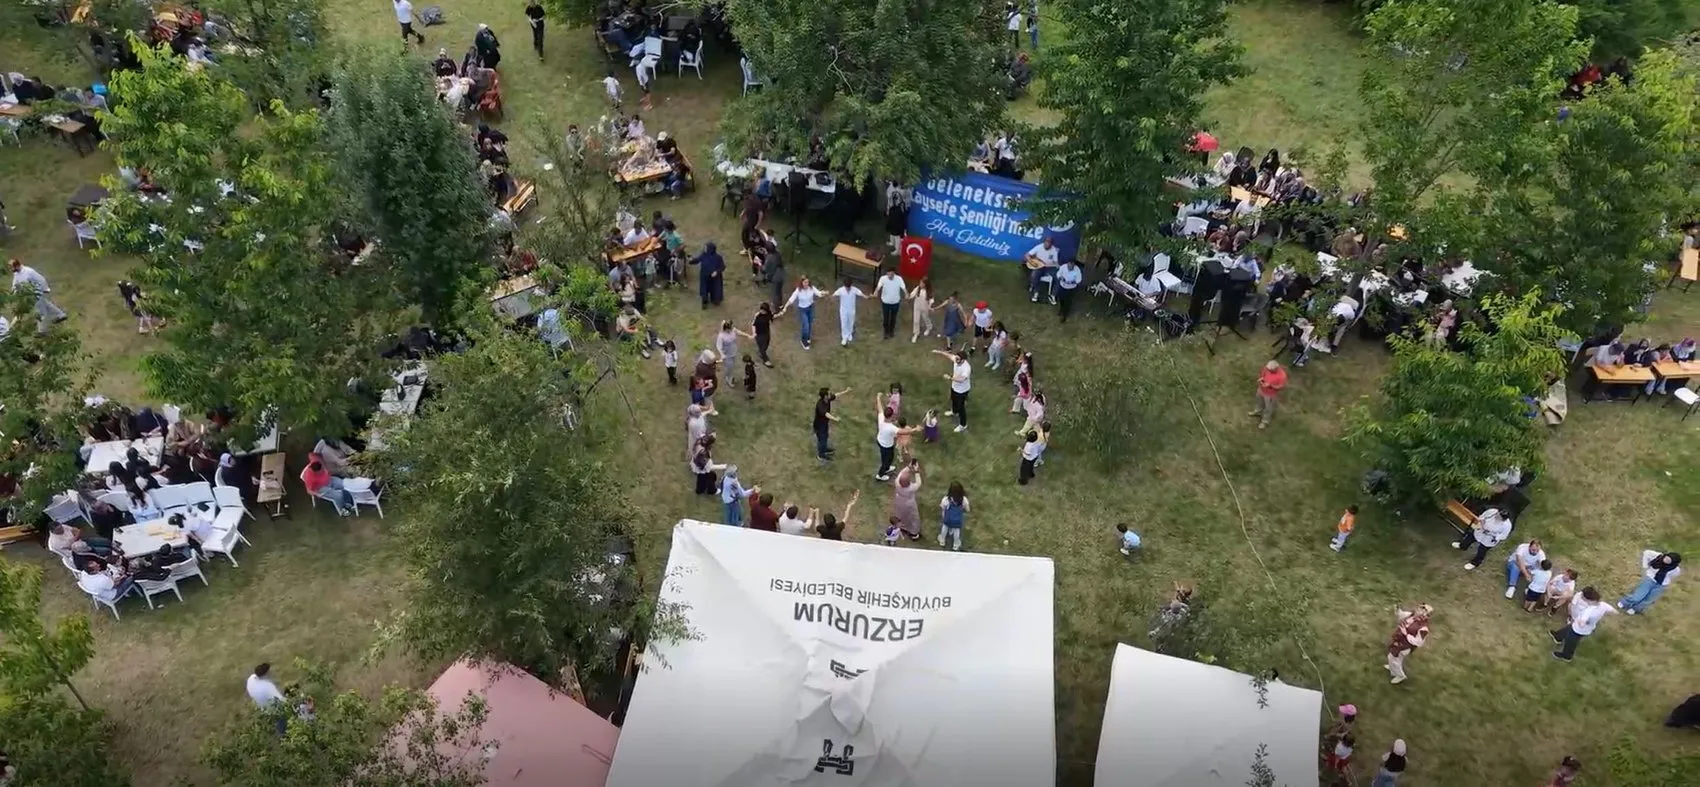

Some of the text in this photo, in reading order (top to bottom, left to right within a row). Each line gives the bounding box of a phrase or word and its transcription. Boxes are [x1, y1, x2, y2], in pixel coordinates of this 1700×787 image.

[770, 577, 952, 613] BÜYÜKŞEHİR BELEDİYESİ
[794, 602, 924, 642] ERZURUM
